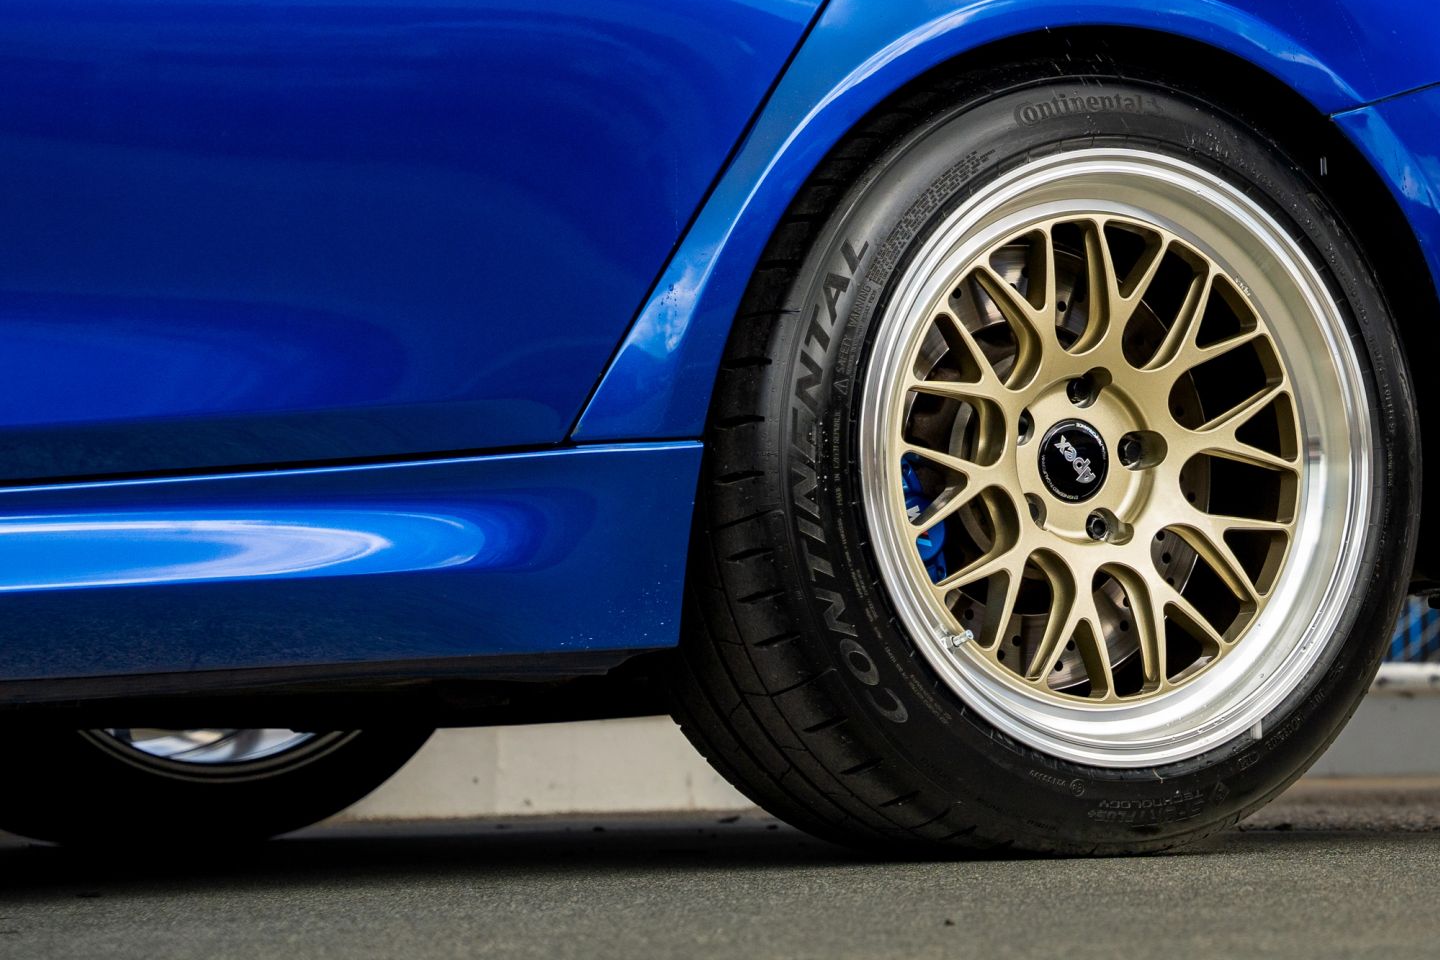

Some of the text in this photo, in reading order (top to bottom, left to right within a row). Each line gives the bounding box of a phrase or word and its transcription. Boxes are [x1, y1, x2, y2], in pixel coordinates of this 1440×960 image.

[1014, 93, 1144, 128] Continental
[848, 284, 872, 328] WARNING
[789, 239, 909, 723] CONTINENTAL
